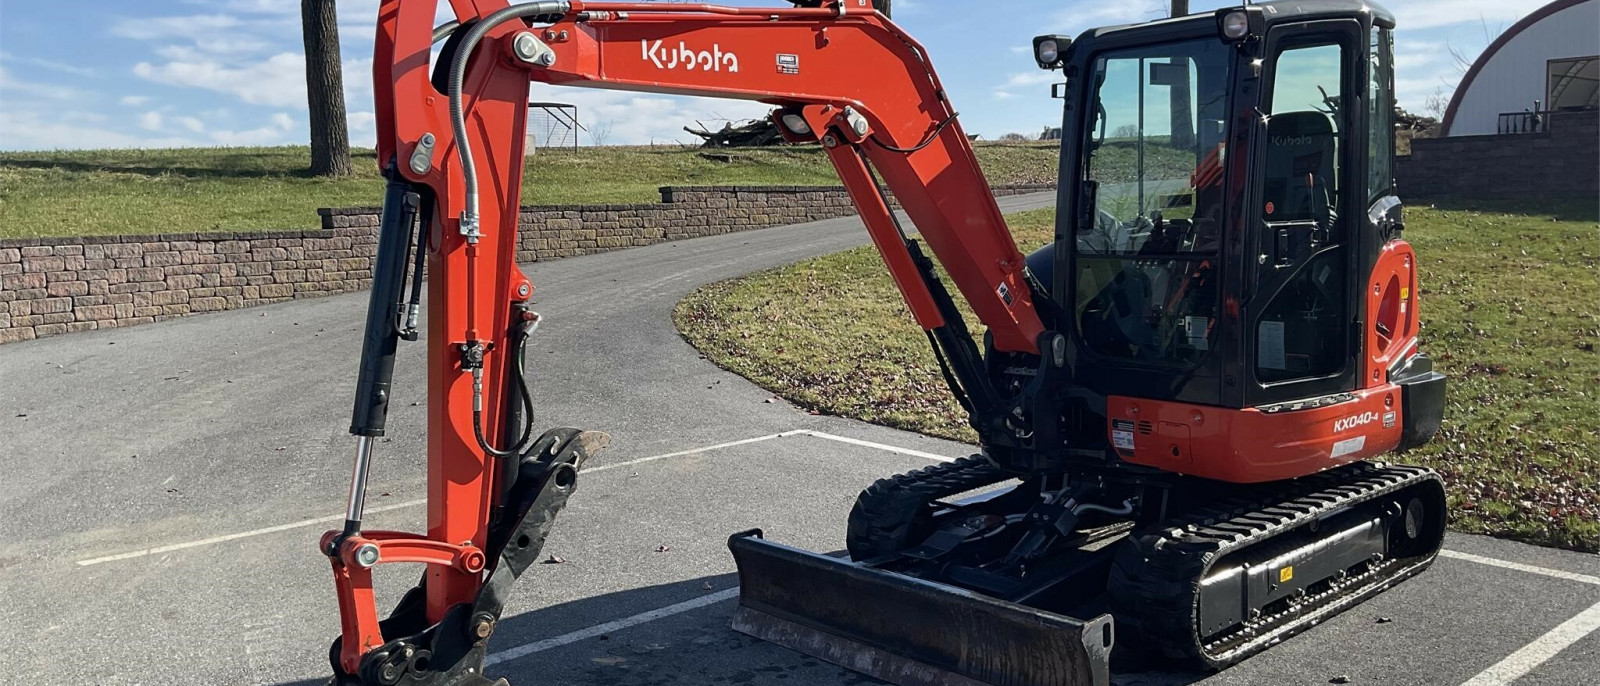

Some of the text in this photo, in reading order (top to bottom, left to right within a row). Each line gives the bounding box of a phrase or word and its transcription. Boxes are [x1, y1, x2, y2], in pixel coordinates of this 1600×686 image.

[641, 38, 739, 73] Kubota
[1271, 134, 1312, 146] Kubota
[1333, 411, 1379, 433] KX040-4
